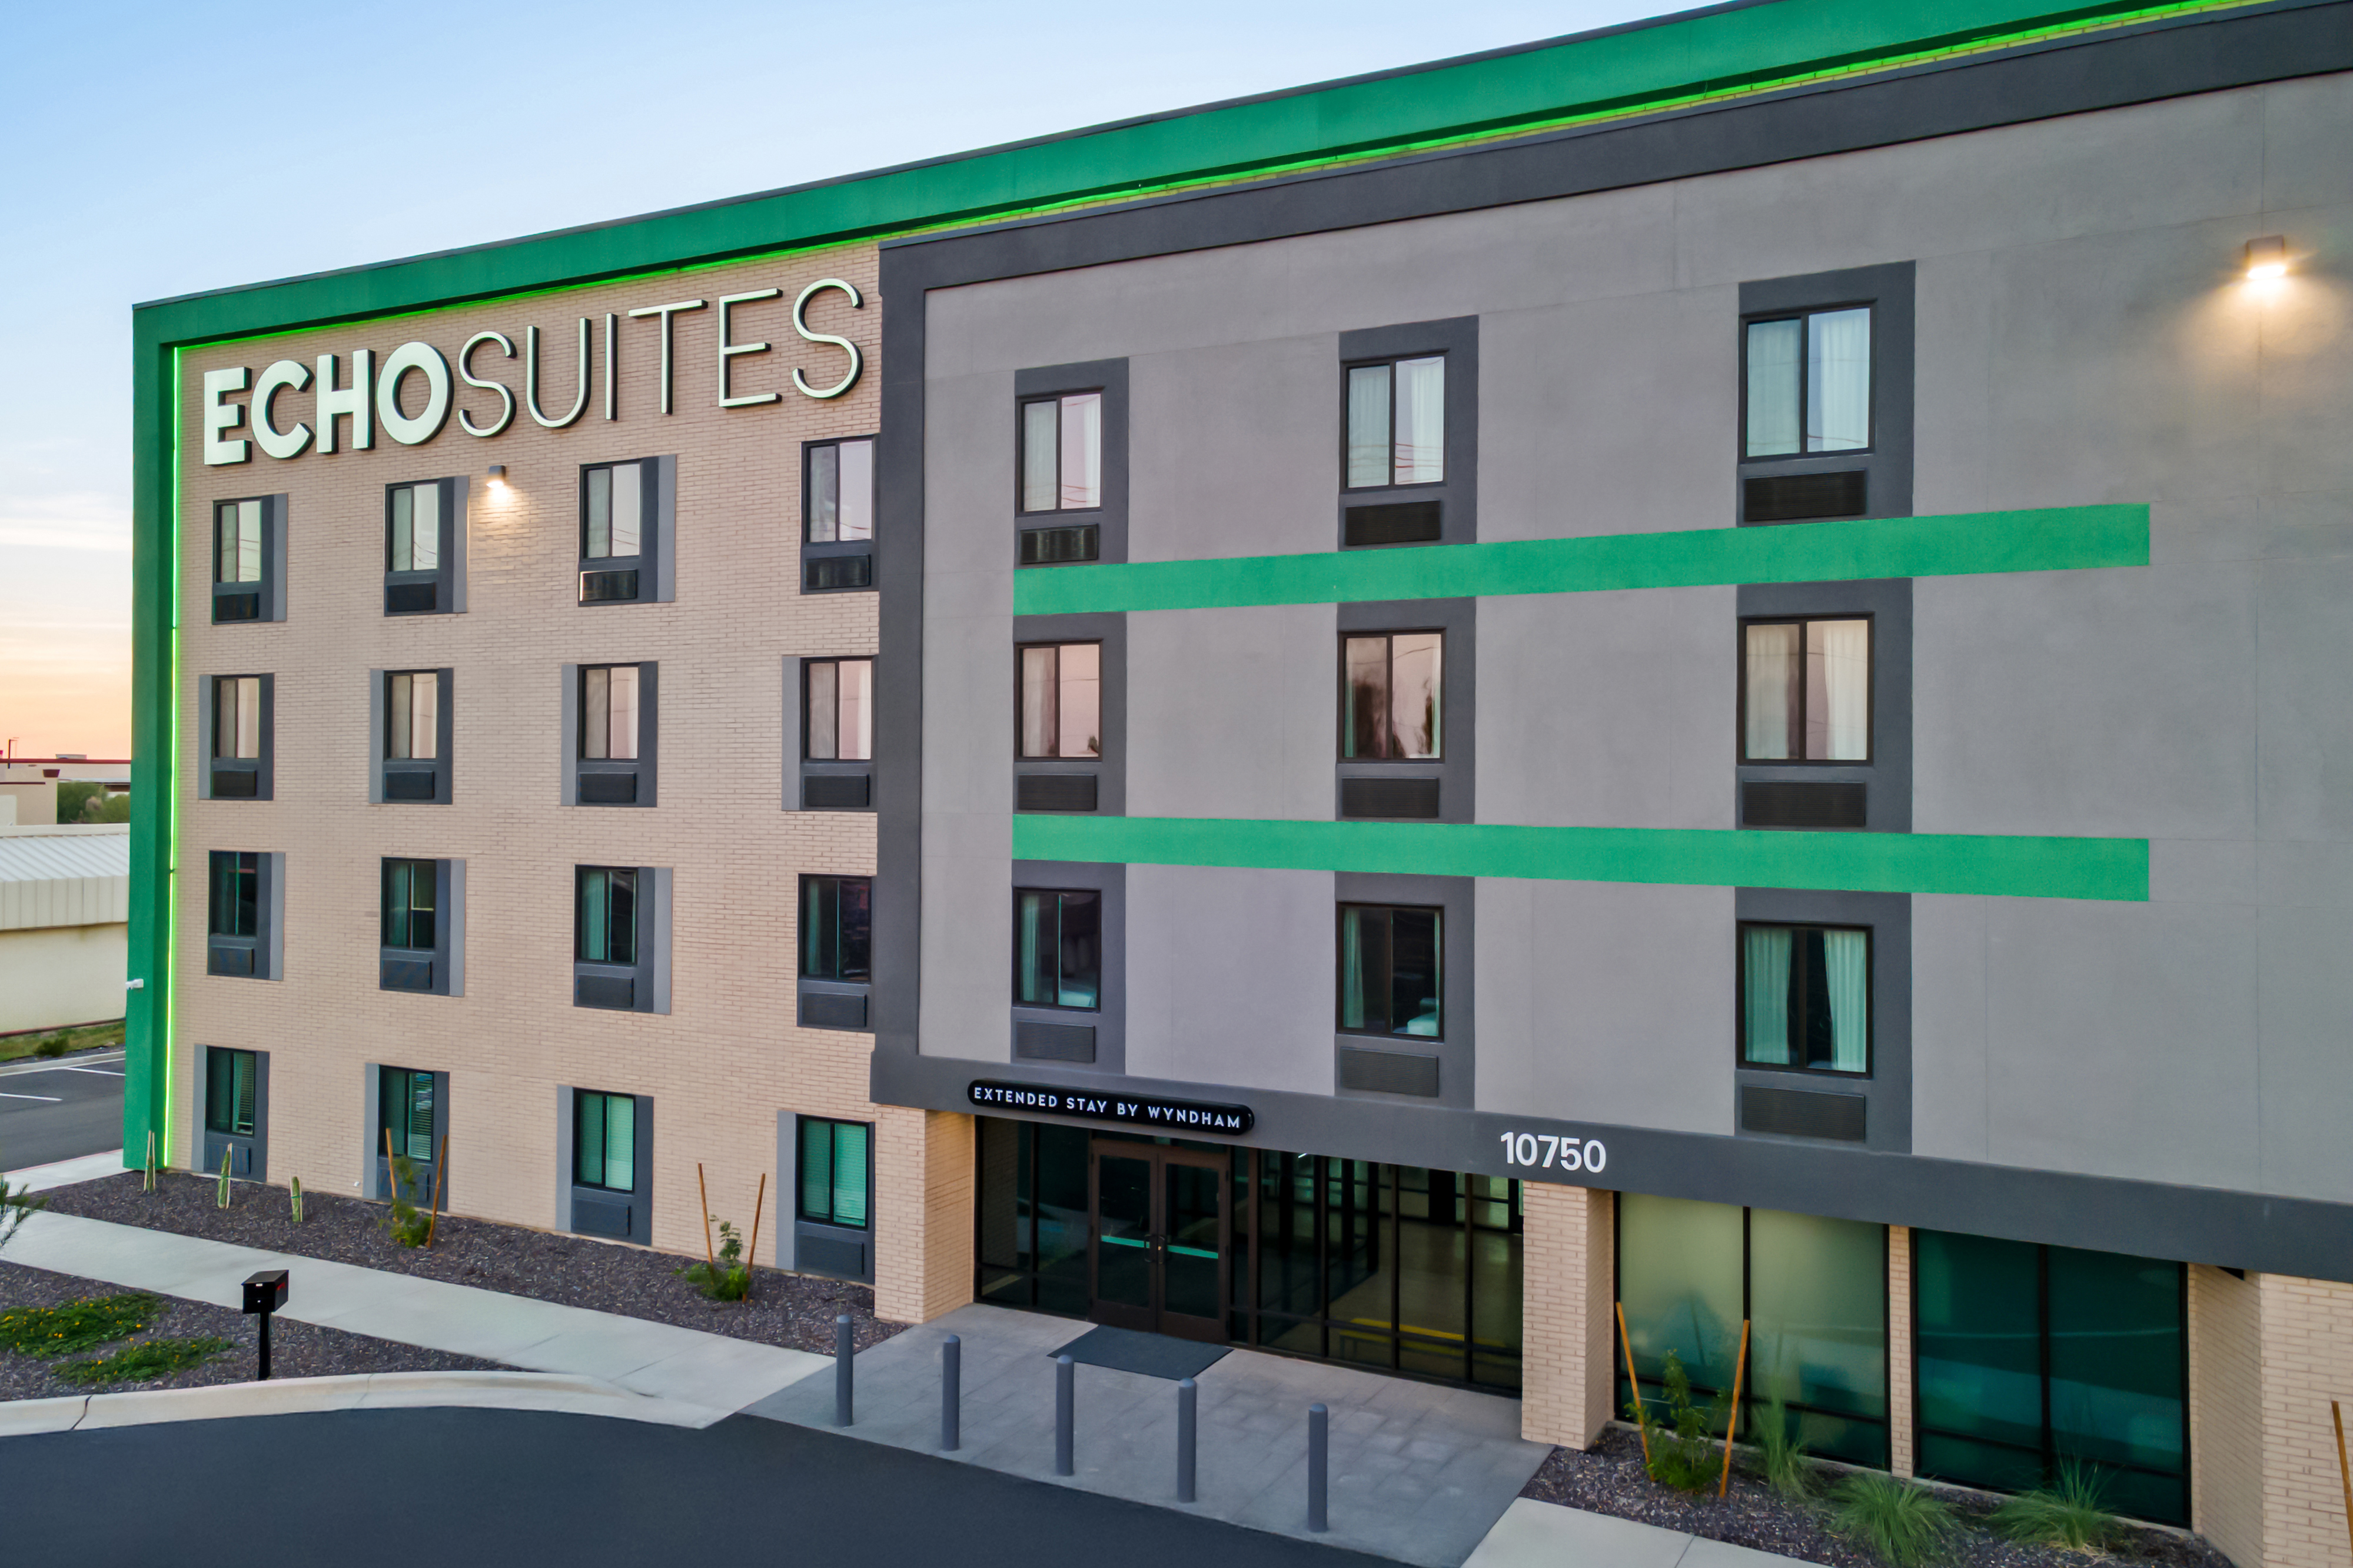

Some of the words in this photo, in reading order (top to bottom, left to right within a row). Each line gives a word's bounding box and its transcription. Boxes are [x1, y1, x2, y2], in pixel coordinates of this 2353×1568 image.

[974, 1087, 1057, 1107] EXTENDED
[1066, 1097, 1106, 1113] STAY
[1117, 1103, 1138, 1117] BY
[1148, 1106, 1239, 1128] WYNDHAM
[1500, 1131, 1606, 1173] 10750
